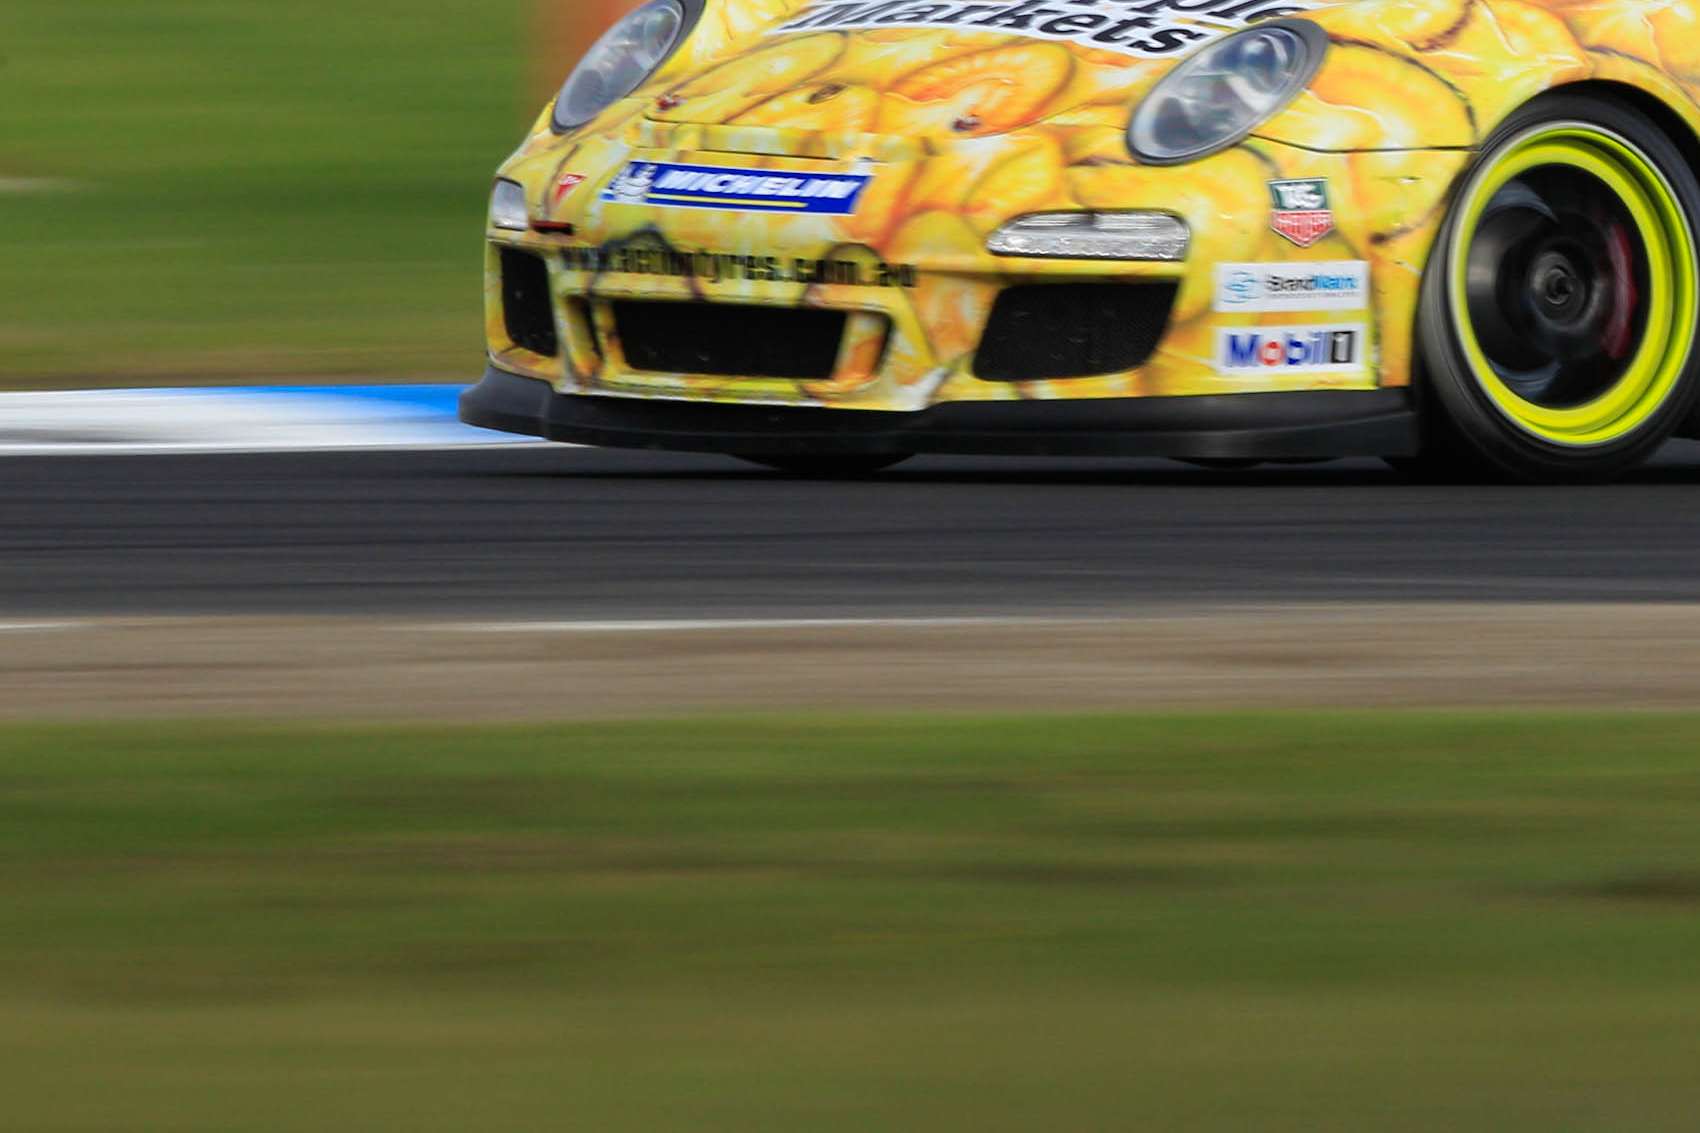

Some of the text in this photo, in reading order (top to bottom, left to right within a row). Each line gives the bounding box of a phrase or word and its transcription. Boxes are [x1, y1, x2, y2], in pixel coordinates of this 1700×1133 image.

[779, 0, 1210, 53] Markets
[653, 169, 862, 199] MICHELIN
[1226, 331, 1330, 366] Mobil
